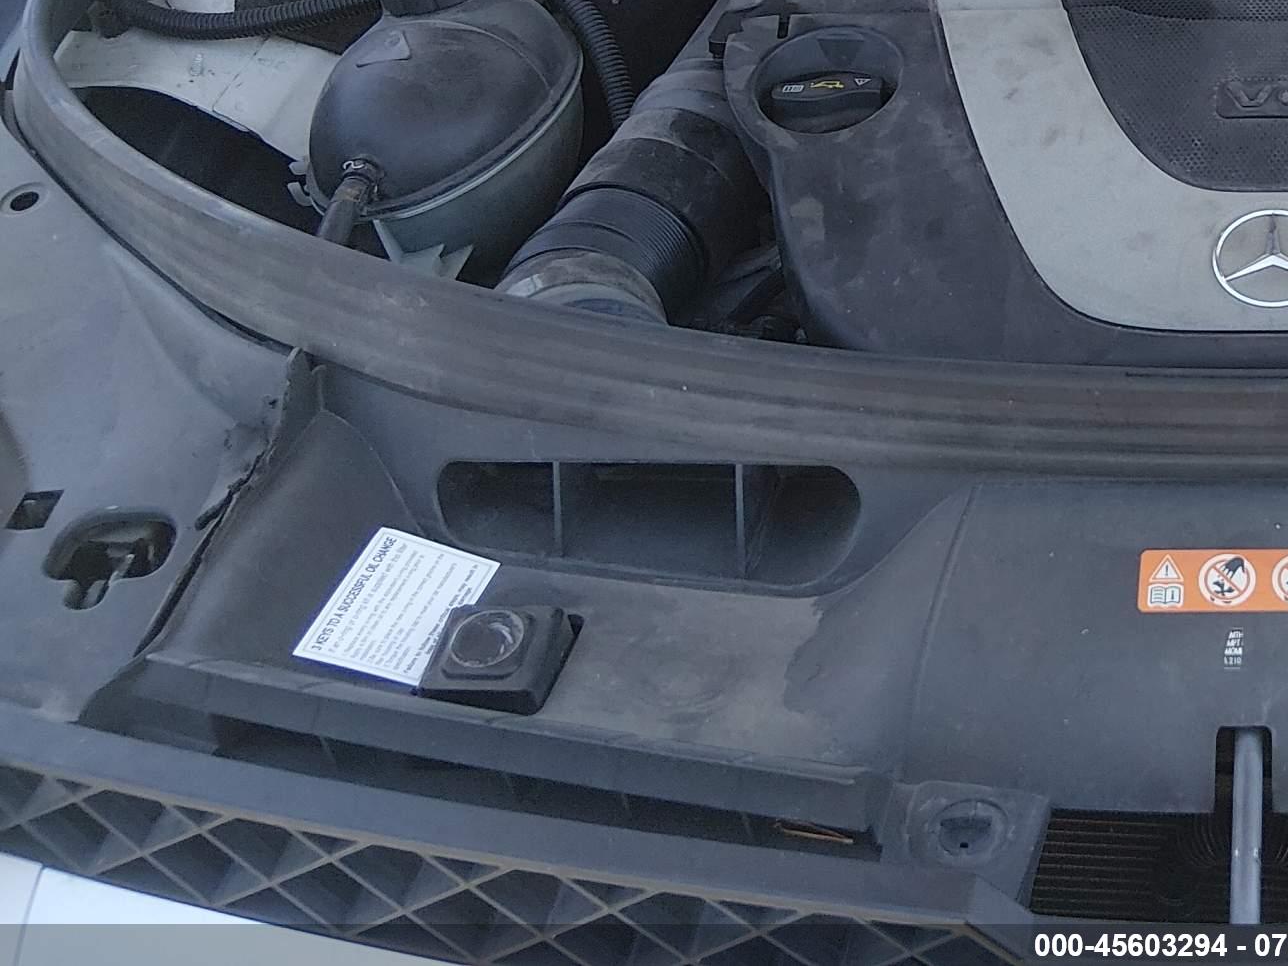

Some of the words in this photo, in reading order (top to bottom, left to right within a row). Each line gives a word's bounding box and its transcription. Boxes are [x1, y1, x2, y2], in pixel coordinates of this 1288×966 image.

[372, 536, 397, 562] CHANGE
[365, 563, 380, 573] OIL
[337, 574, 372, 612] SUCCESSFUL
[326, 617, 340, 627] TO
[315, 627, 334, 644] KEYS
